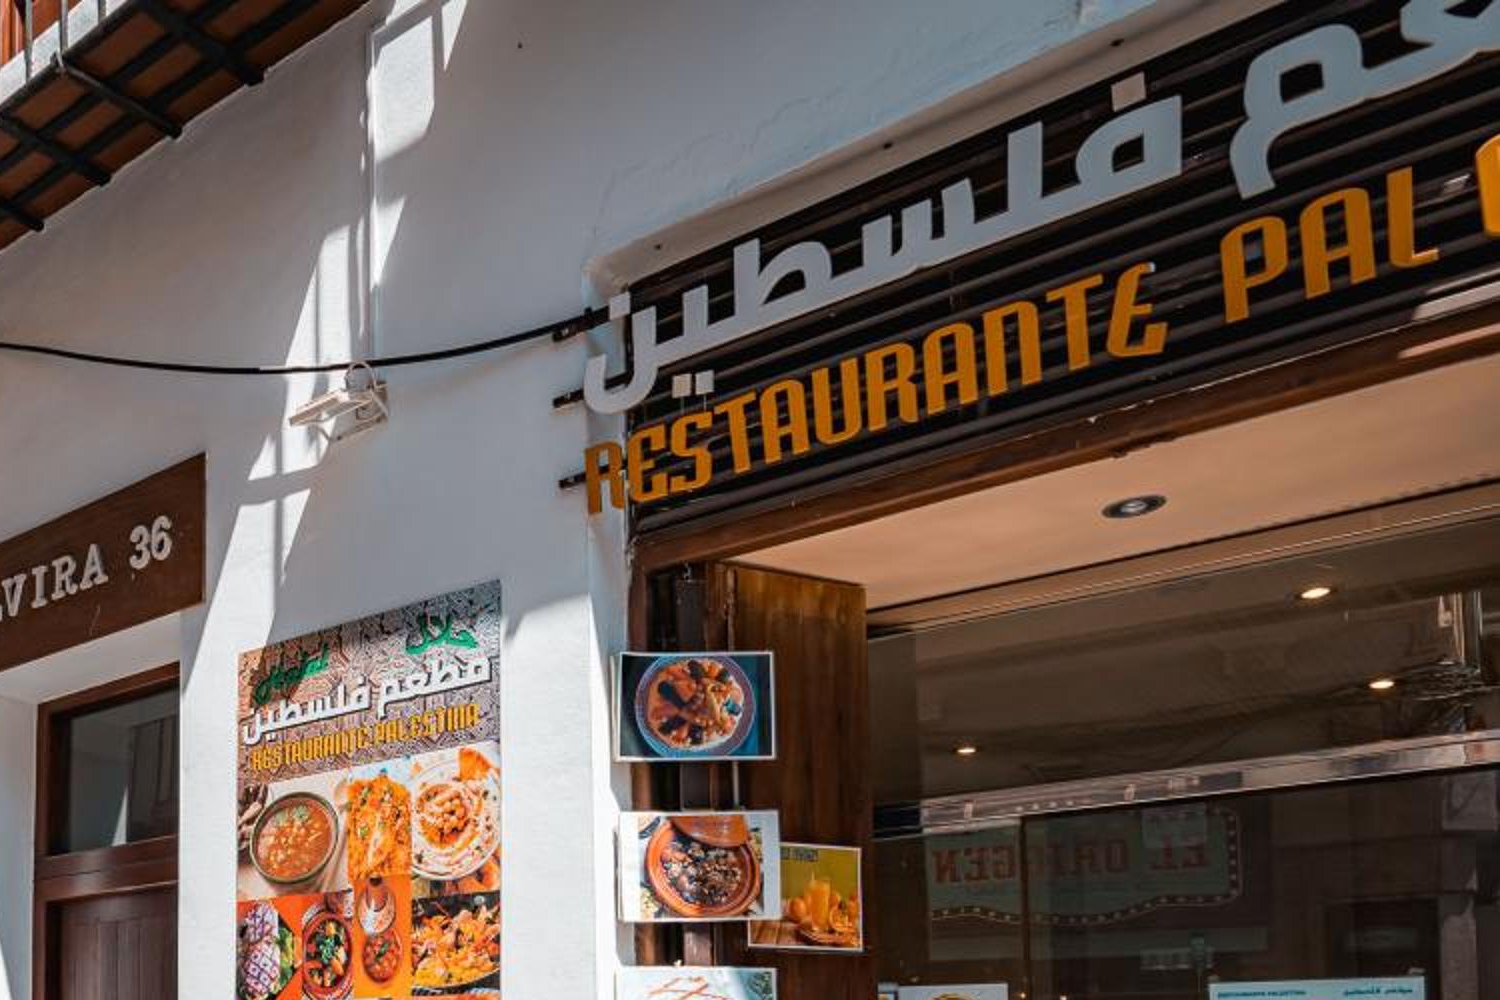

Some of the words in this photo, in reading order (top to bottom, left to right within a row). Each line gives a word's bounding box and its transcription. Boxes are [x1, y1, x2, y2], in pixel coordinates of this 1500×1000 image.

[583, 71, 1182, 414] فلسطين
[584, 262, 1168, 514] RESTAURANTE
[129, 515, 173, 569] 36
[405, 614, 479, 656] حلال
[243, 675, 372, 745] فلسطين
[377, 655, 492, 720] مطعم
[252, 728, 371, 770] RESTAURANTE
[375, 703, 481, 744] PALESTINA
